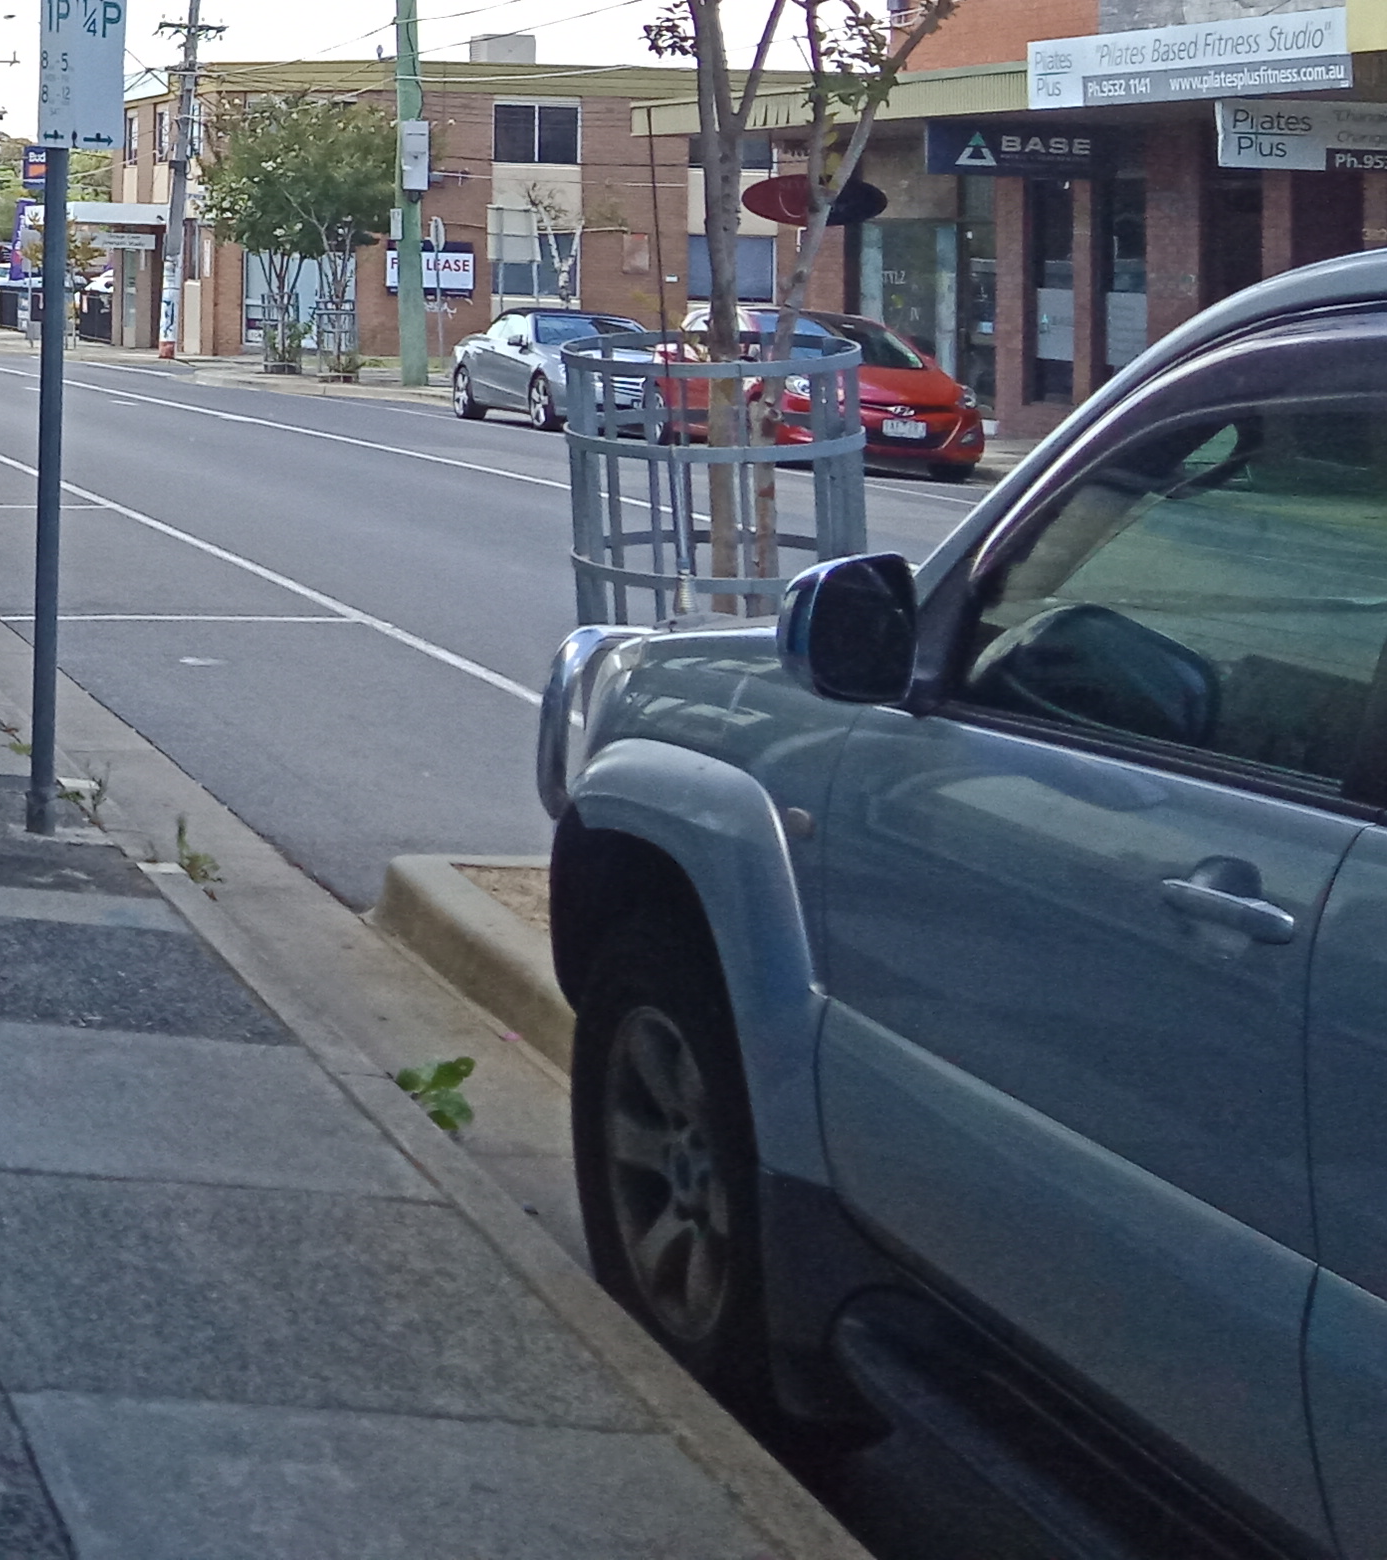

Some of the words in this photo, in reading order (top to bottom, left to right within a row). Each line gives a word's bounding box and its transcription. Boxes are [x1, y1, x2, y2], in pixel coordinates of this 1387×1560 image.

[1151, 32, 1198, 64] Based
[1203, 31, 1261, 58] Fitness
[1034, 50, 1073, 71] Pilates
[1035, 75, 1062, 98] Plus
[1129, 75, 1151, 95] 1141
[1170, 63, 1345, 93] www.pilatesplusfitness.com.au
[1231, 108, 1313, 132] Pilates
[1001, 134, 1091, 156] BASE
[1237, 135, 1288, 158] Plus
[427, 258, 470, 273] LEASE
